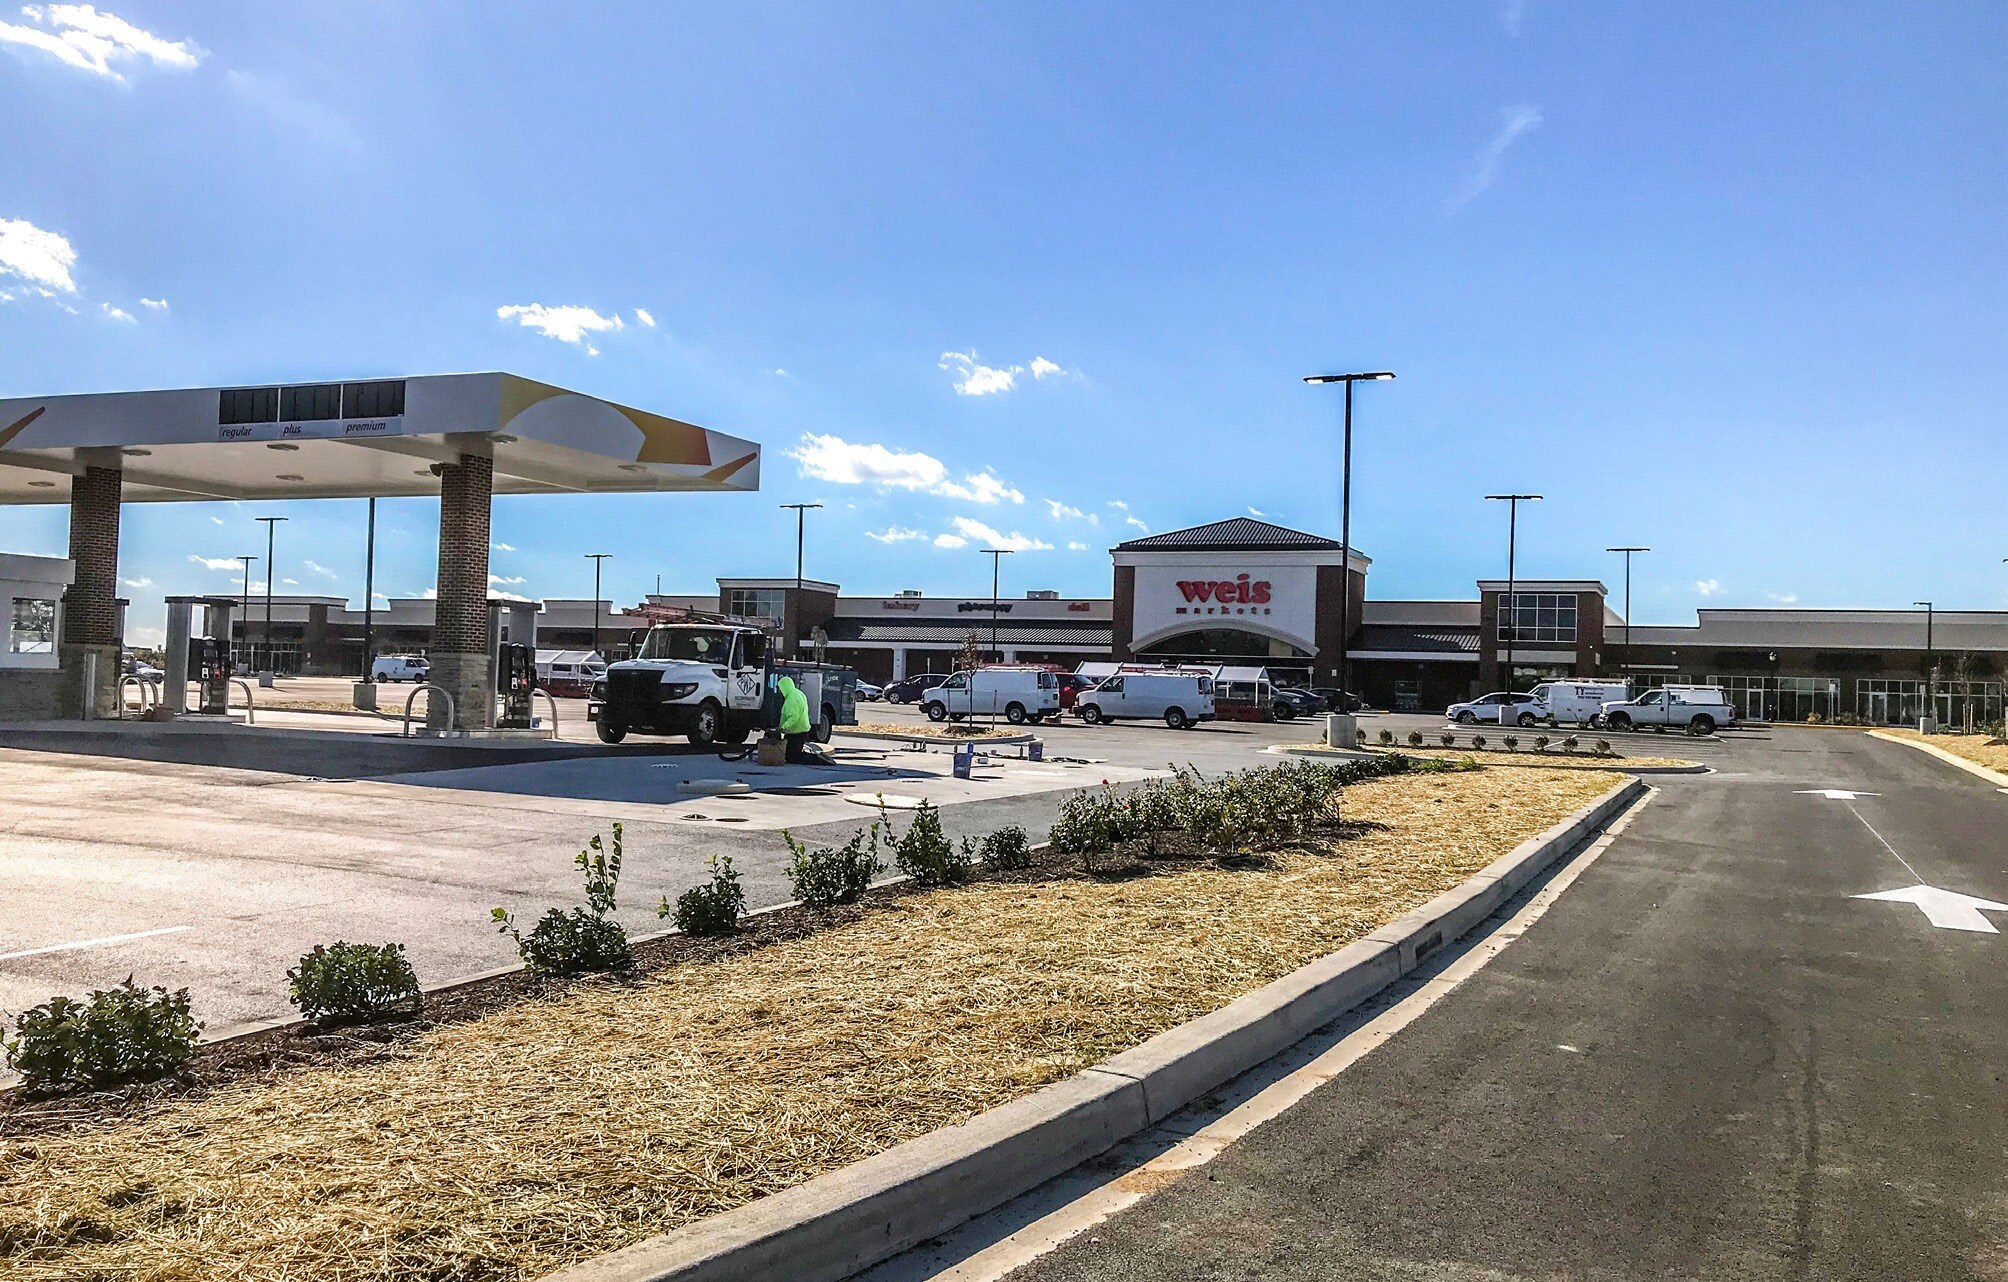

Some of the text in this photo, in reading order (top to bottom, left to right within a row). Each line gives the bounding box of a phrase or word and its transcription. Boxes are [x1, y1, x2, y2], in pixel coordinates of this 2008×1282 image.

[222, 426, 252, 438] regular
[283, 424, 301, 436] plus
[345, 421, 386, 434] premium
[1176, 573, 1271, 603] weis
[1068, 602, 1090, 612] deli
[1176, 606, 1271, 615] markets
